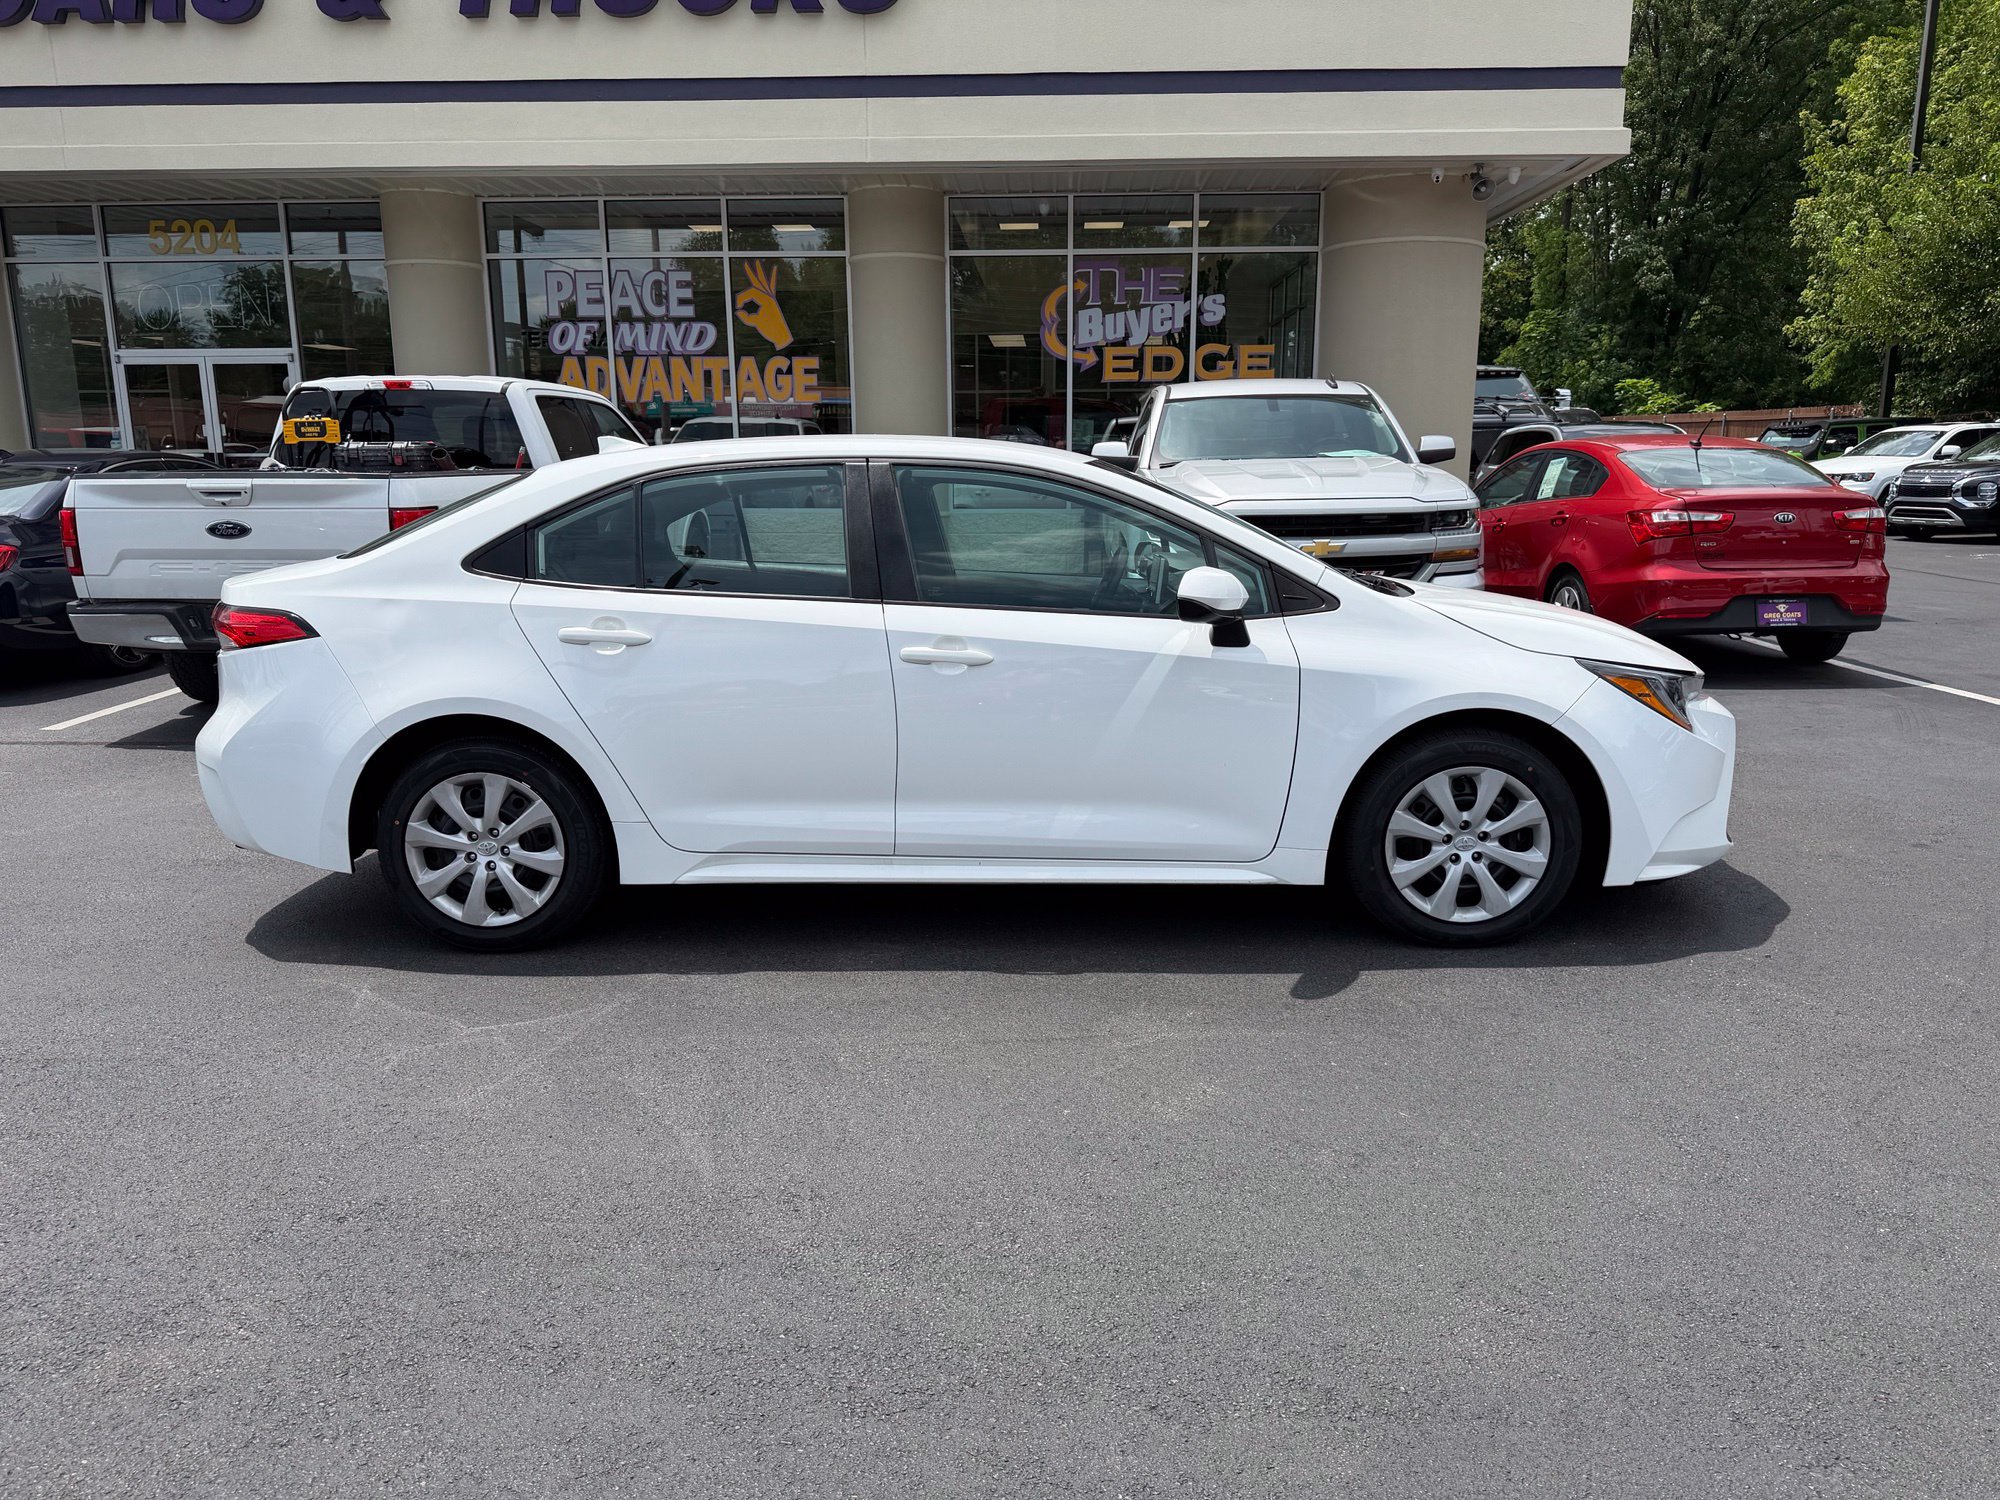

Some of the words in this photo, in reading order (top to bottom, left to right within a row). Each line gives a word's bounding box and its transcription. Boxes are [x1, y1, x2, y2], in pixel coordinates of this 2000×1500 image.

[149, 218, 241, 255] 5204
[545, 270, 696, 318] PEACE
[1074, 259, 1185, 305] THE
[138, 283, 274, 330] OPEN
[1074, 293, 1227, 348] Buyer's
[548, 321, 601, 355] OF
[614, 321, 717, 355] MIND
[559, 356, 823, 404] ADVANTAGE
[1102, 344, 1275, 382] EDGE
[215, 523, 241, 535] Ford
[1777, 514, 1795, 523] KIA
